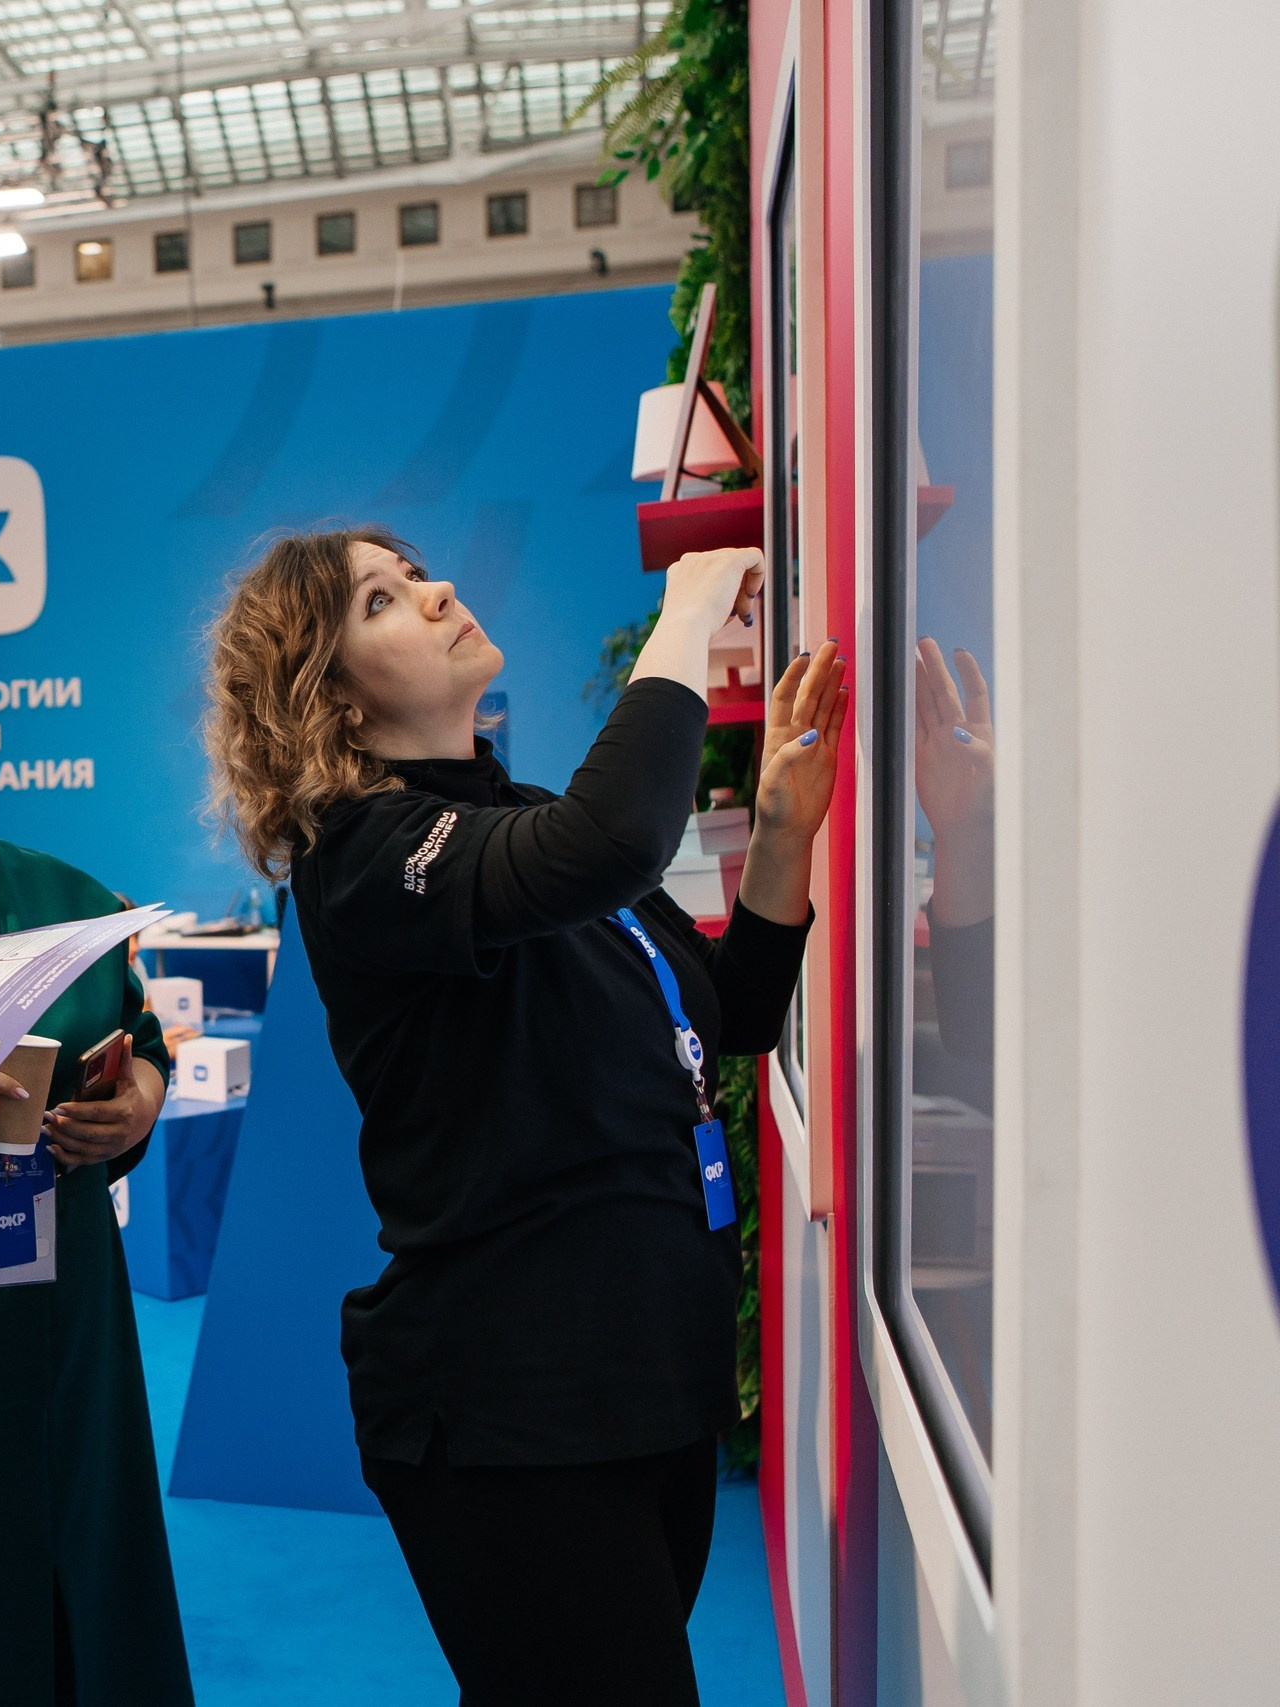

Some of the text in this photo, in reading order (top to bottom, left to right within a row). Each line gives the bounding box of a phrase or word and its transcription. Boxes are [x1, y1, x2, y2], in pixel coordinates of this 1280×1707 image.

[404, 811, 451, 891] ВДОХНОВЛЯЕМ
[416, 823, 454, 894] НА РАЗВИТИЕ
[630, 926, 656, 958] ФКР
[705, 1161, 724, 1182] ФКР
